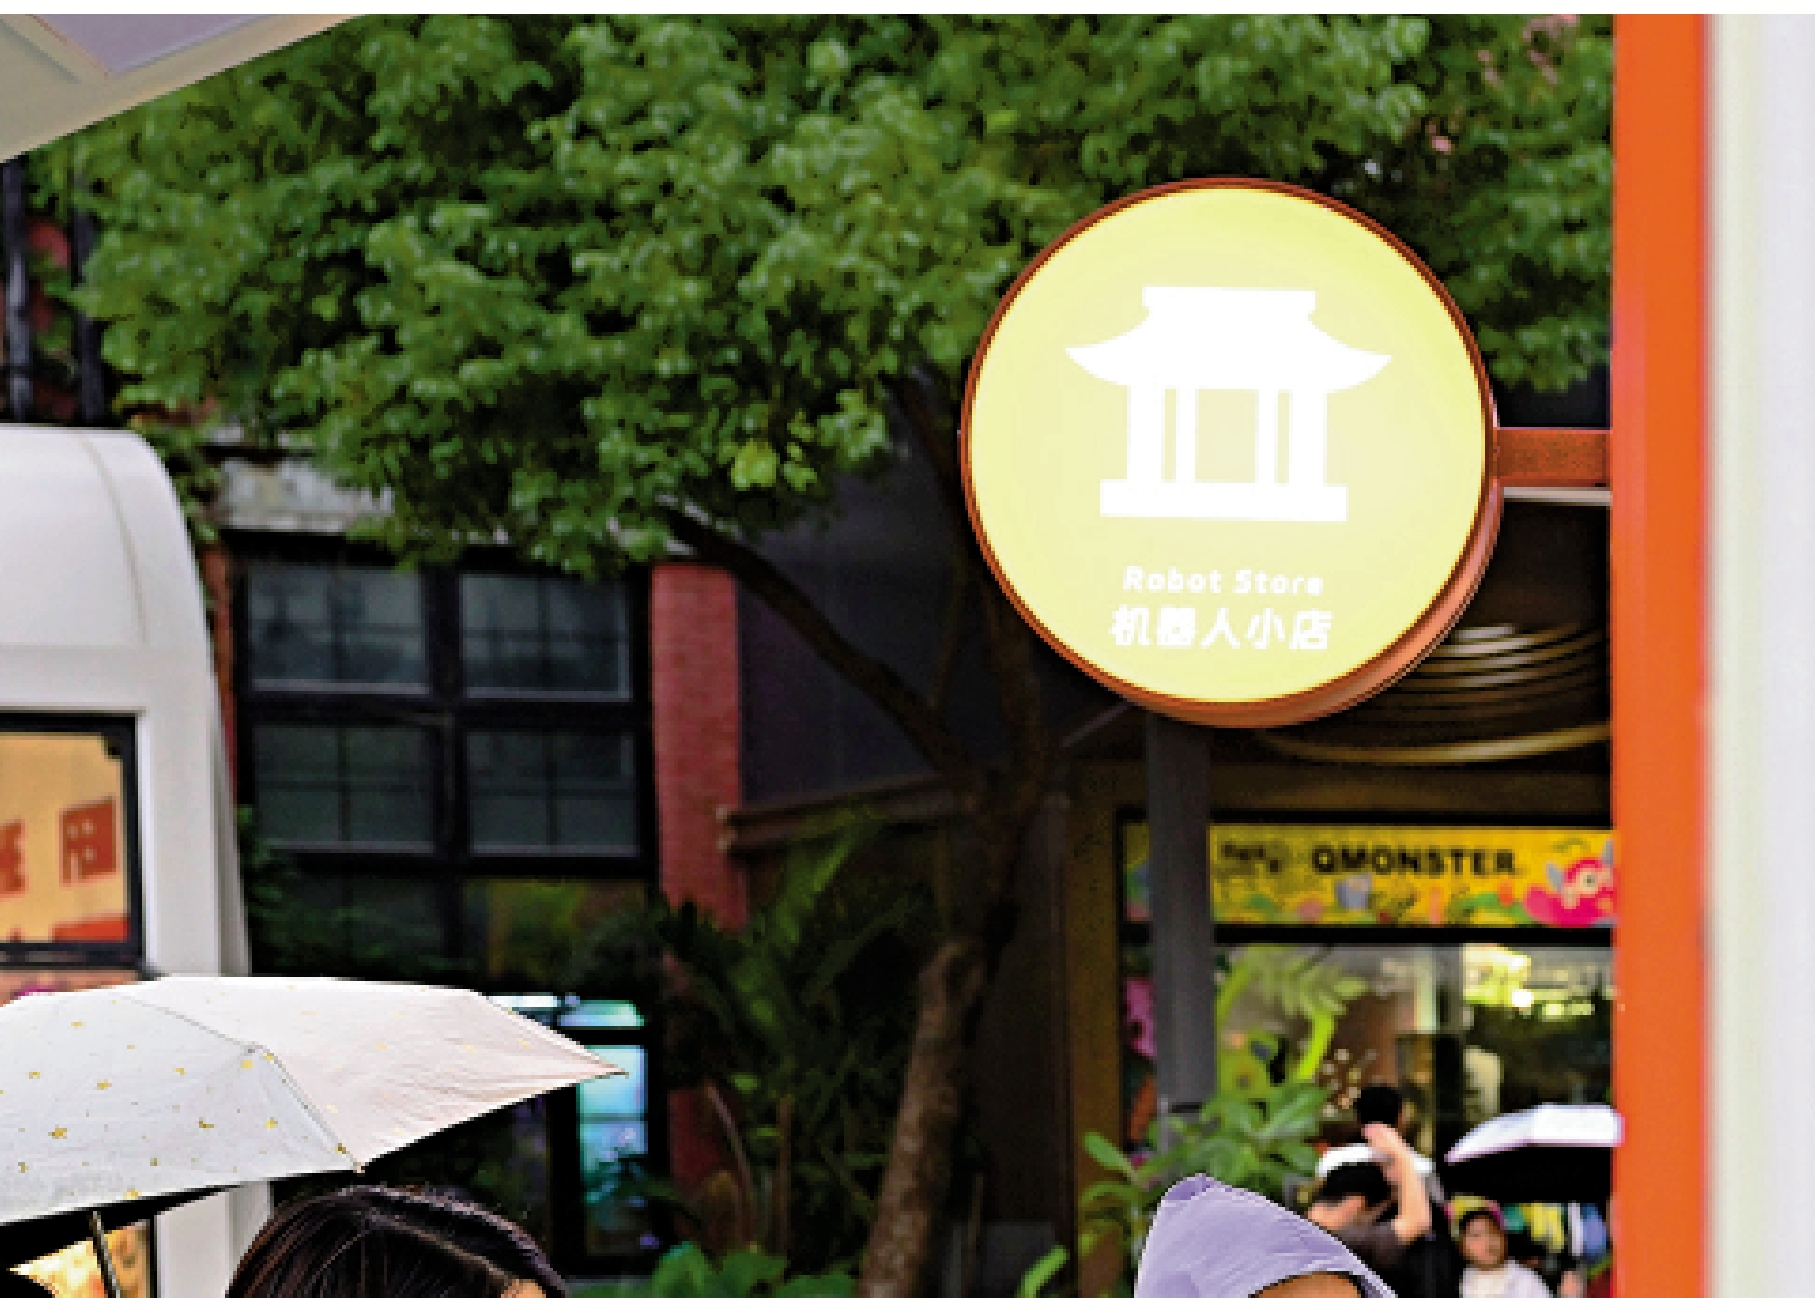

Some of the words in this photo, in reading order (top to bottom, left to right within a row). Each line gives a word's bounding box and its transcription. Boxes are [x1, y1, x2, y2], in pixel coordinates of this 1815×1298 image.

[1122, 565, 1222, 593] Robot
[1233, 569, 1324, 596] Store
[1108, 603, 1334, 650] 机器人小店
[1312, 844, 1522, 876] QMONSTER
